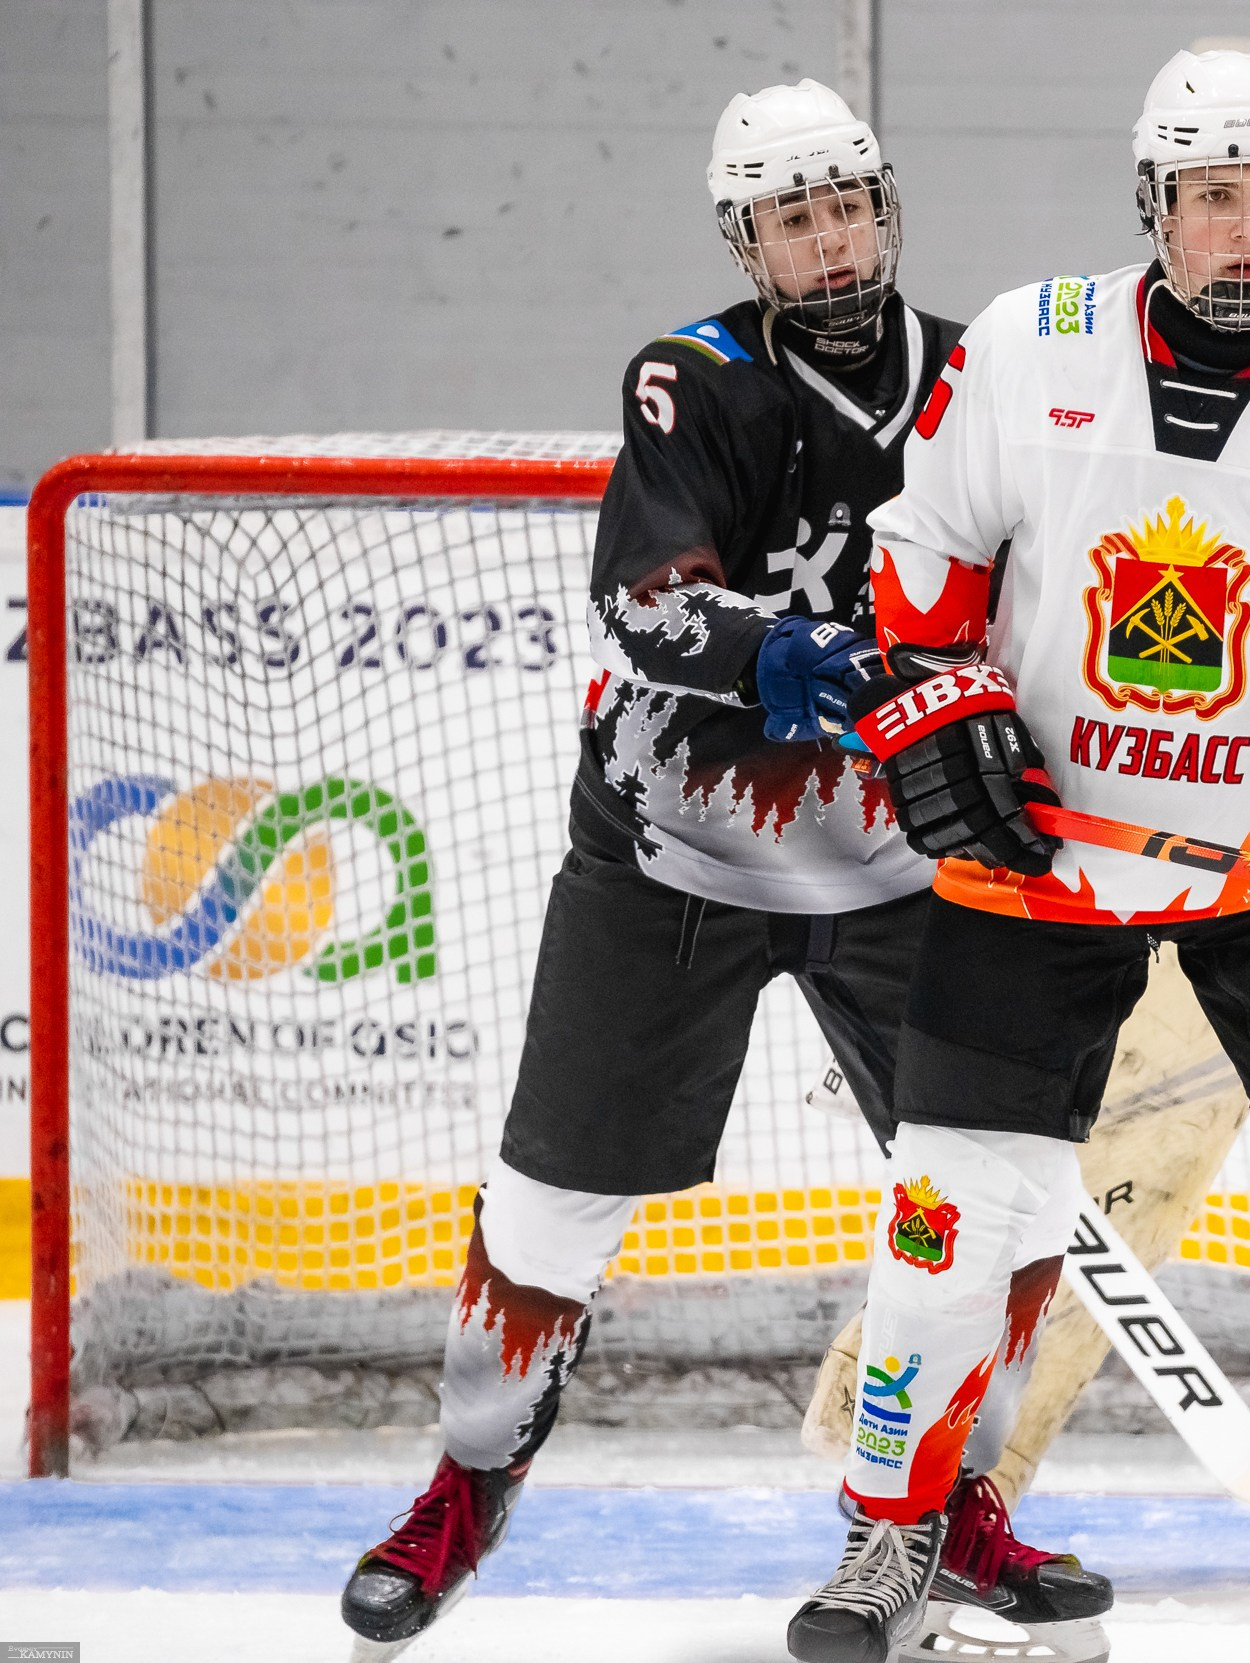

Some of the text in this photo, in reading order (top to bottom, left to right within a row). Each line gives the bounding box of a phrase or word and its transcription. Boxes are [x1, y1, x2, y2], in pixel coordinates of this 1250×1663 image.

[814, 343, 869, 355] DOCTOR
[815, 337, 861, 348] SHOCK
[634, 361, 680, 436] 5
[1066, 1211, 1224, 1413] AUER
